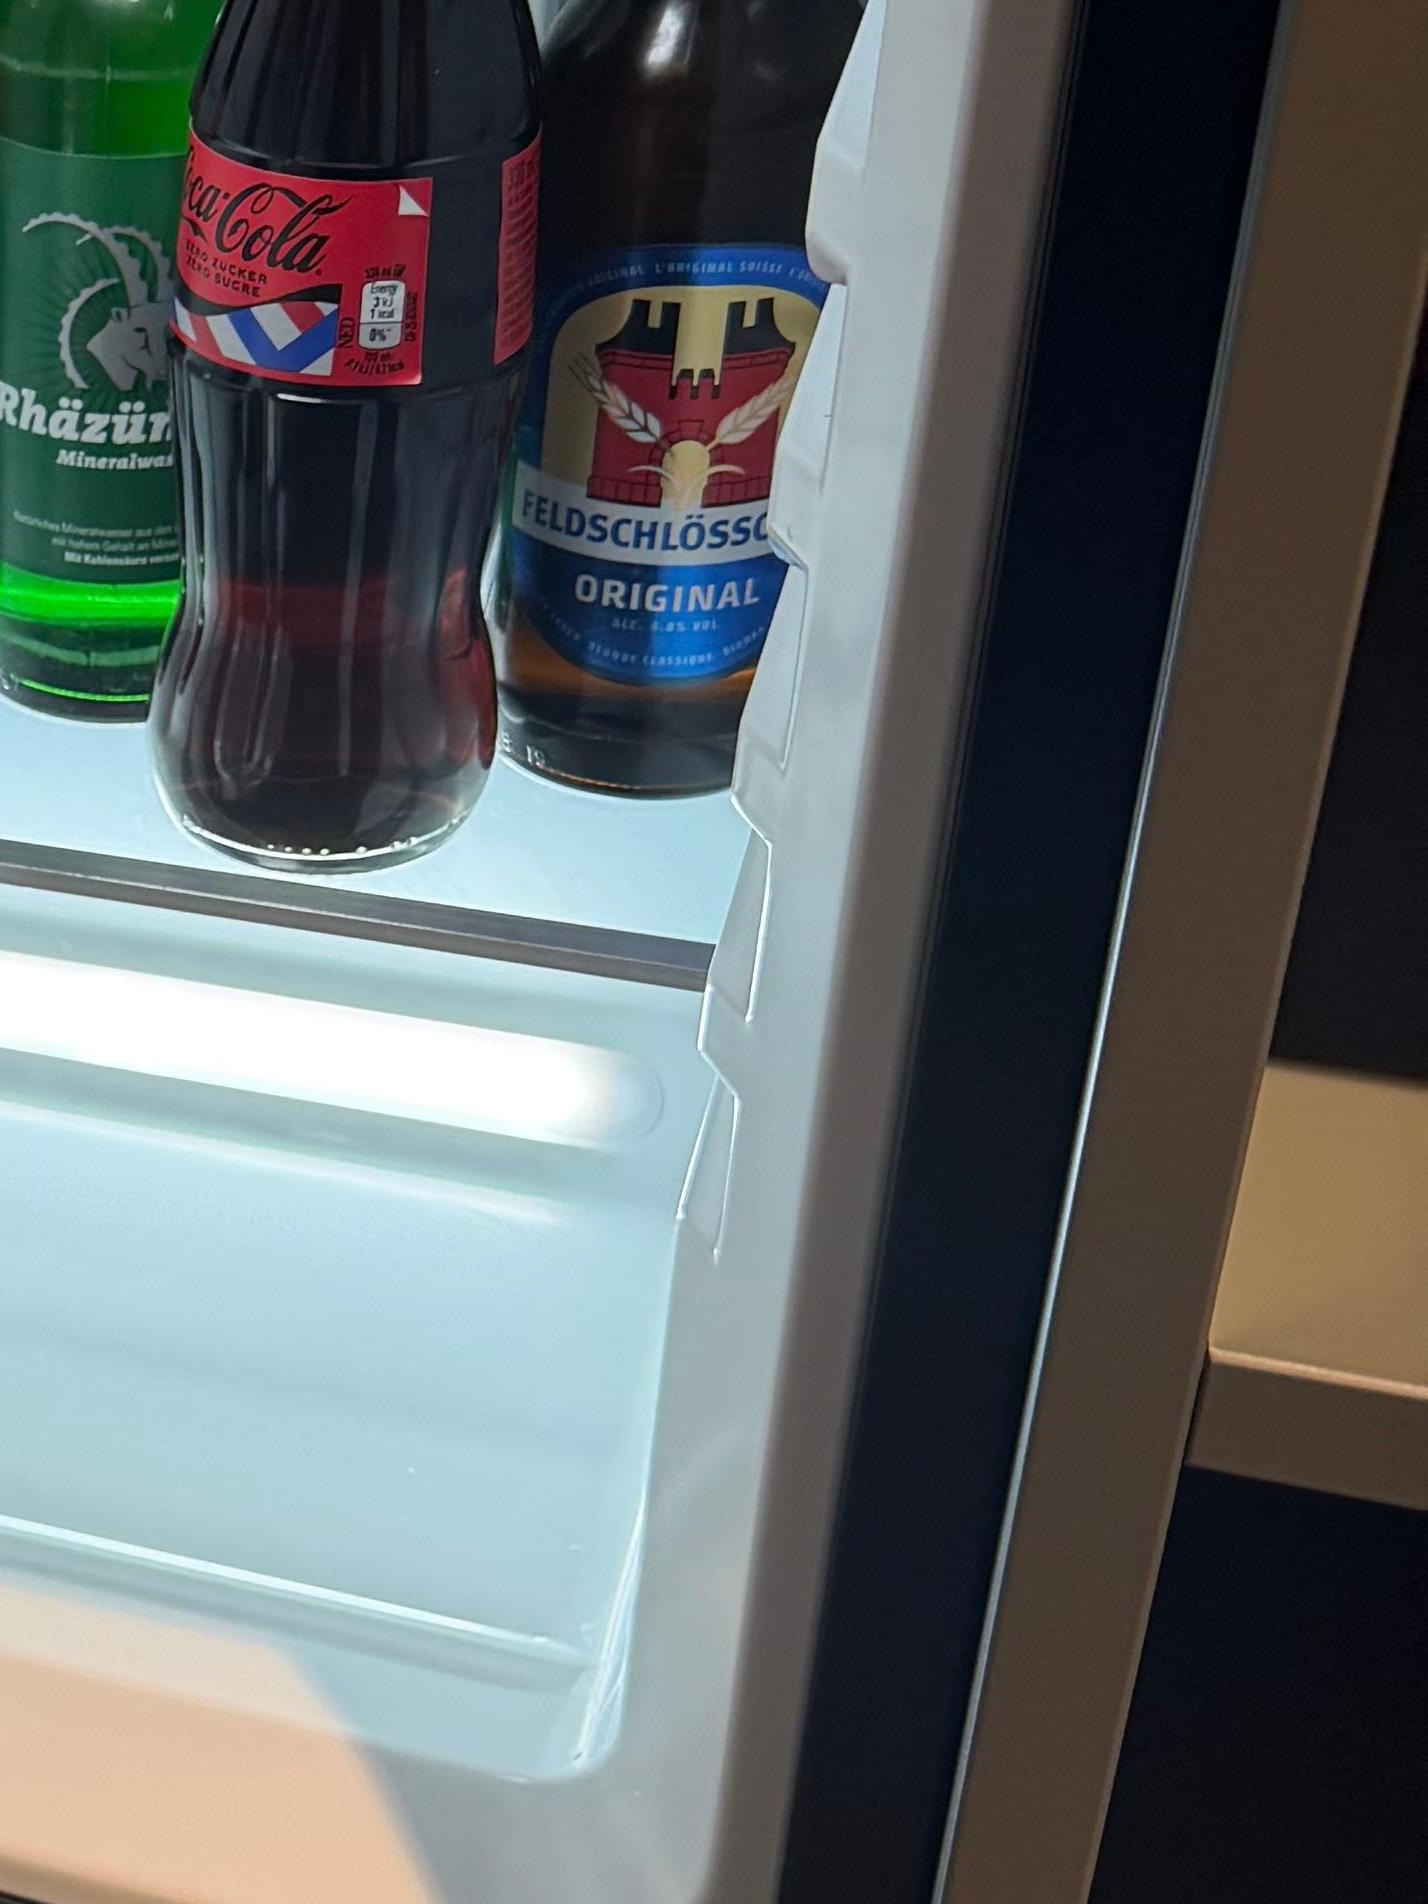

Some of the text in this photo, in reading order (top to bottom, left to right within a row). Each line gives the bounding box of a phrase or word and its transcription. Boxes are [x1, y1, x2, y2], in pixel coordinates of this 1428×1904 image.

[184, 145, 352, 275] ca-Cola
[185, 238, 268, 285] ZERO ZUCKER
[186, 255, 262, 297] ZERO SUCRE
[575, 573, 762, 613] ORIGINAL
